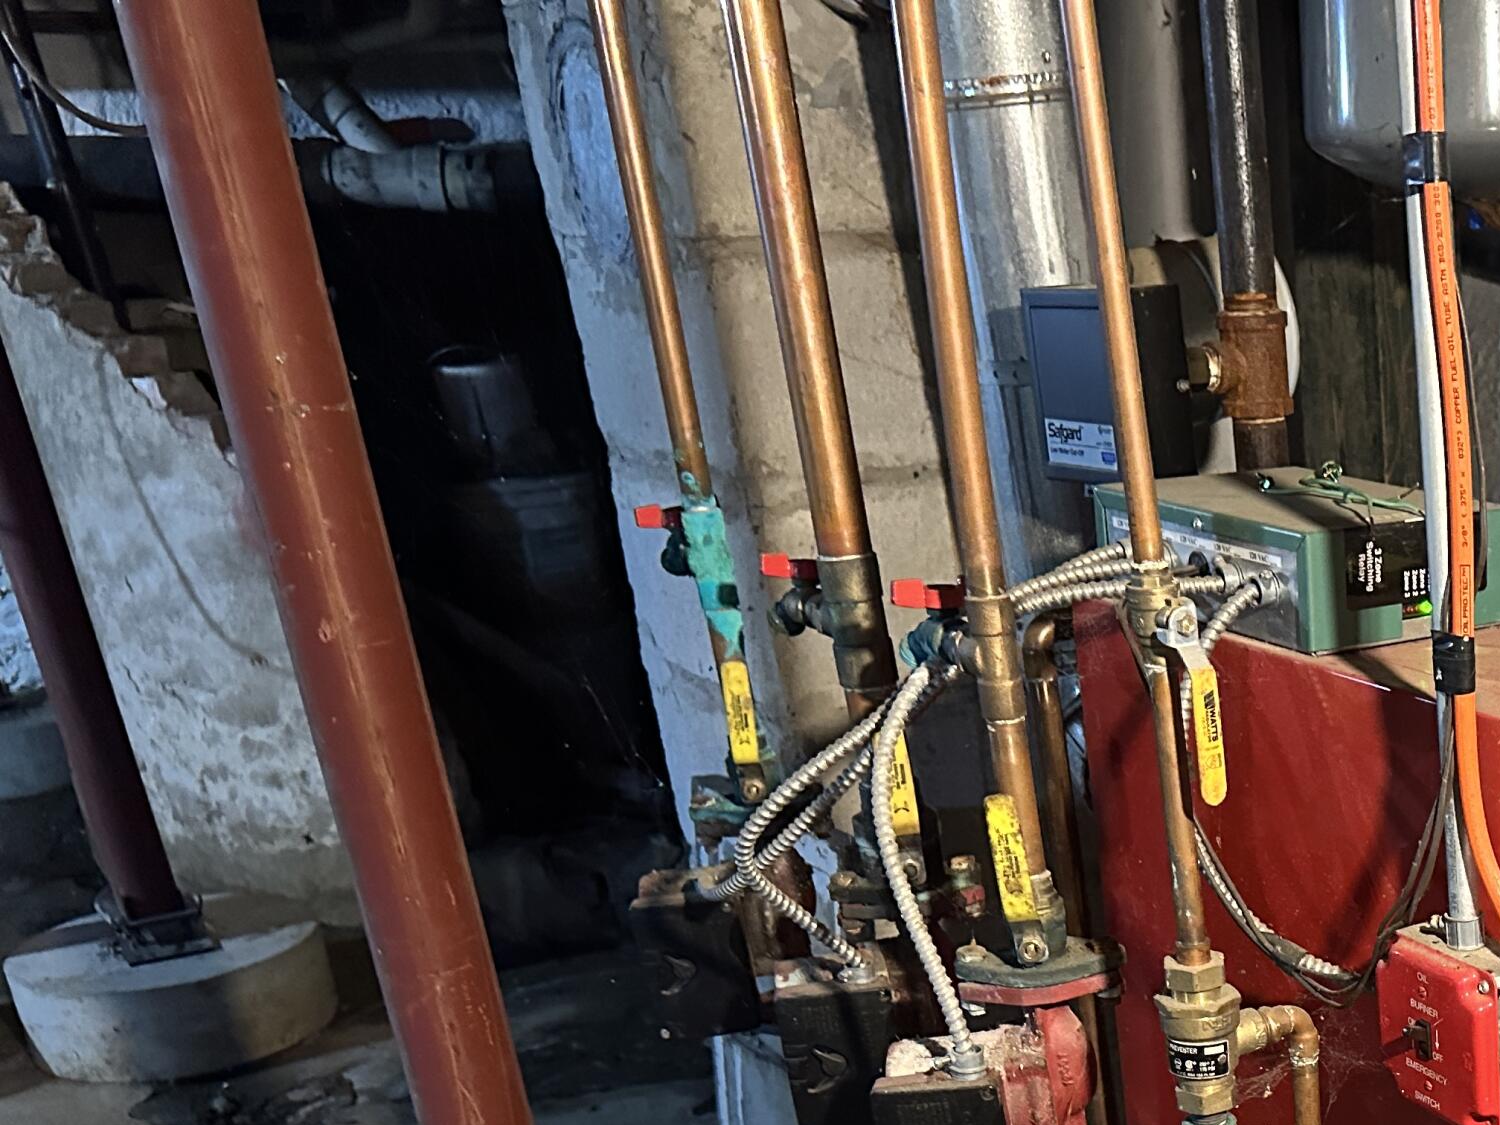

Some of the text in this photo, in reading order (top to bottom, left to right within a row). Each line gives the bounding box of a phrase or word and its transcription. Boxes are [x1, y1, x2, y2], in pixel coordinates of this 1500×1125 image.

[1440, 268, 1449, 295] ASTM
[1443, 302, 1452, 326] TUBE
[1447, 333, 1458, 382] FUEL-OIL
[1453, 386, 1462, 424] COPPER
[1357, 553, 1366, 582] Relay
[1365, 541, 1374, 592] Switching
[1374, 556, 1383, 583] Zone
[1209, 708, 1219, 742] WATTS
[1416, 971, 1429, 985] OIL
[1409, 997, 1439, 1019] BURNER
[1432, 1051, 1444, 1063] OFF
[1405, 1056, 1449, 1086] EMERGENCY
[1414, 1090, 1441, 1111] SWITCH
